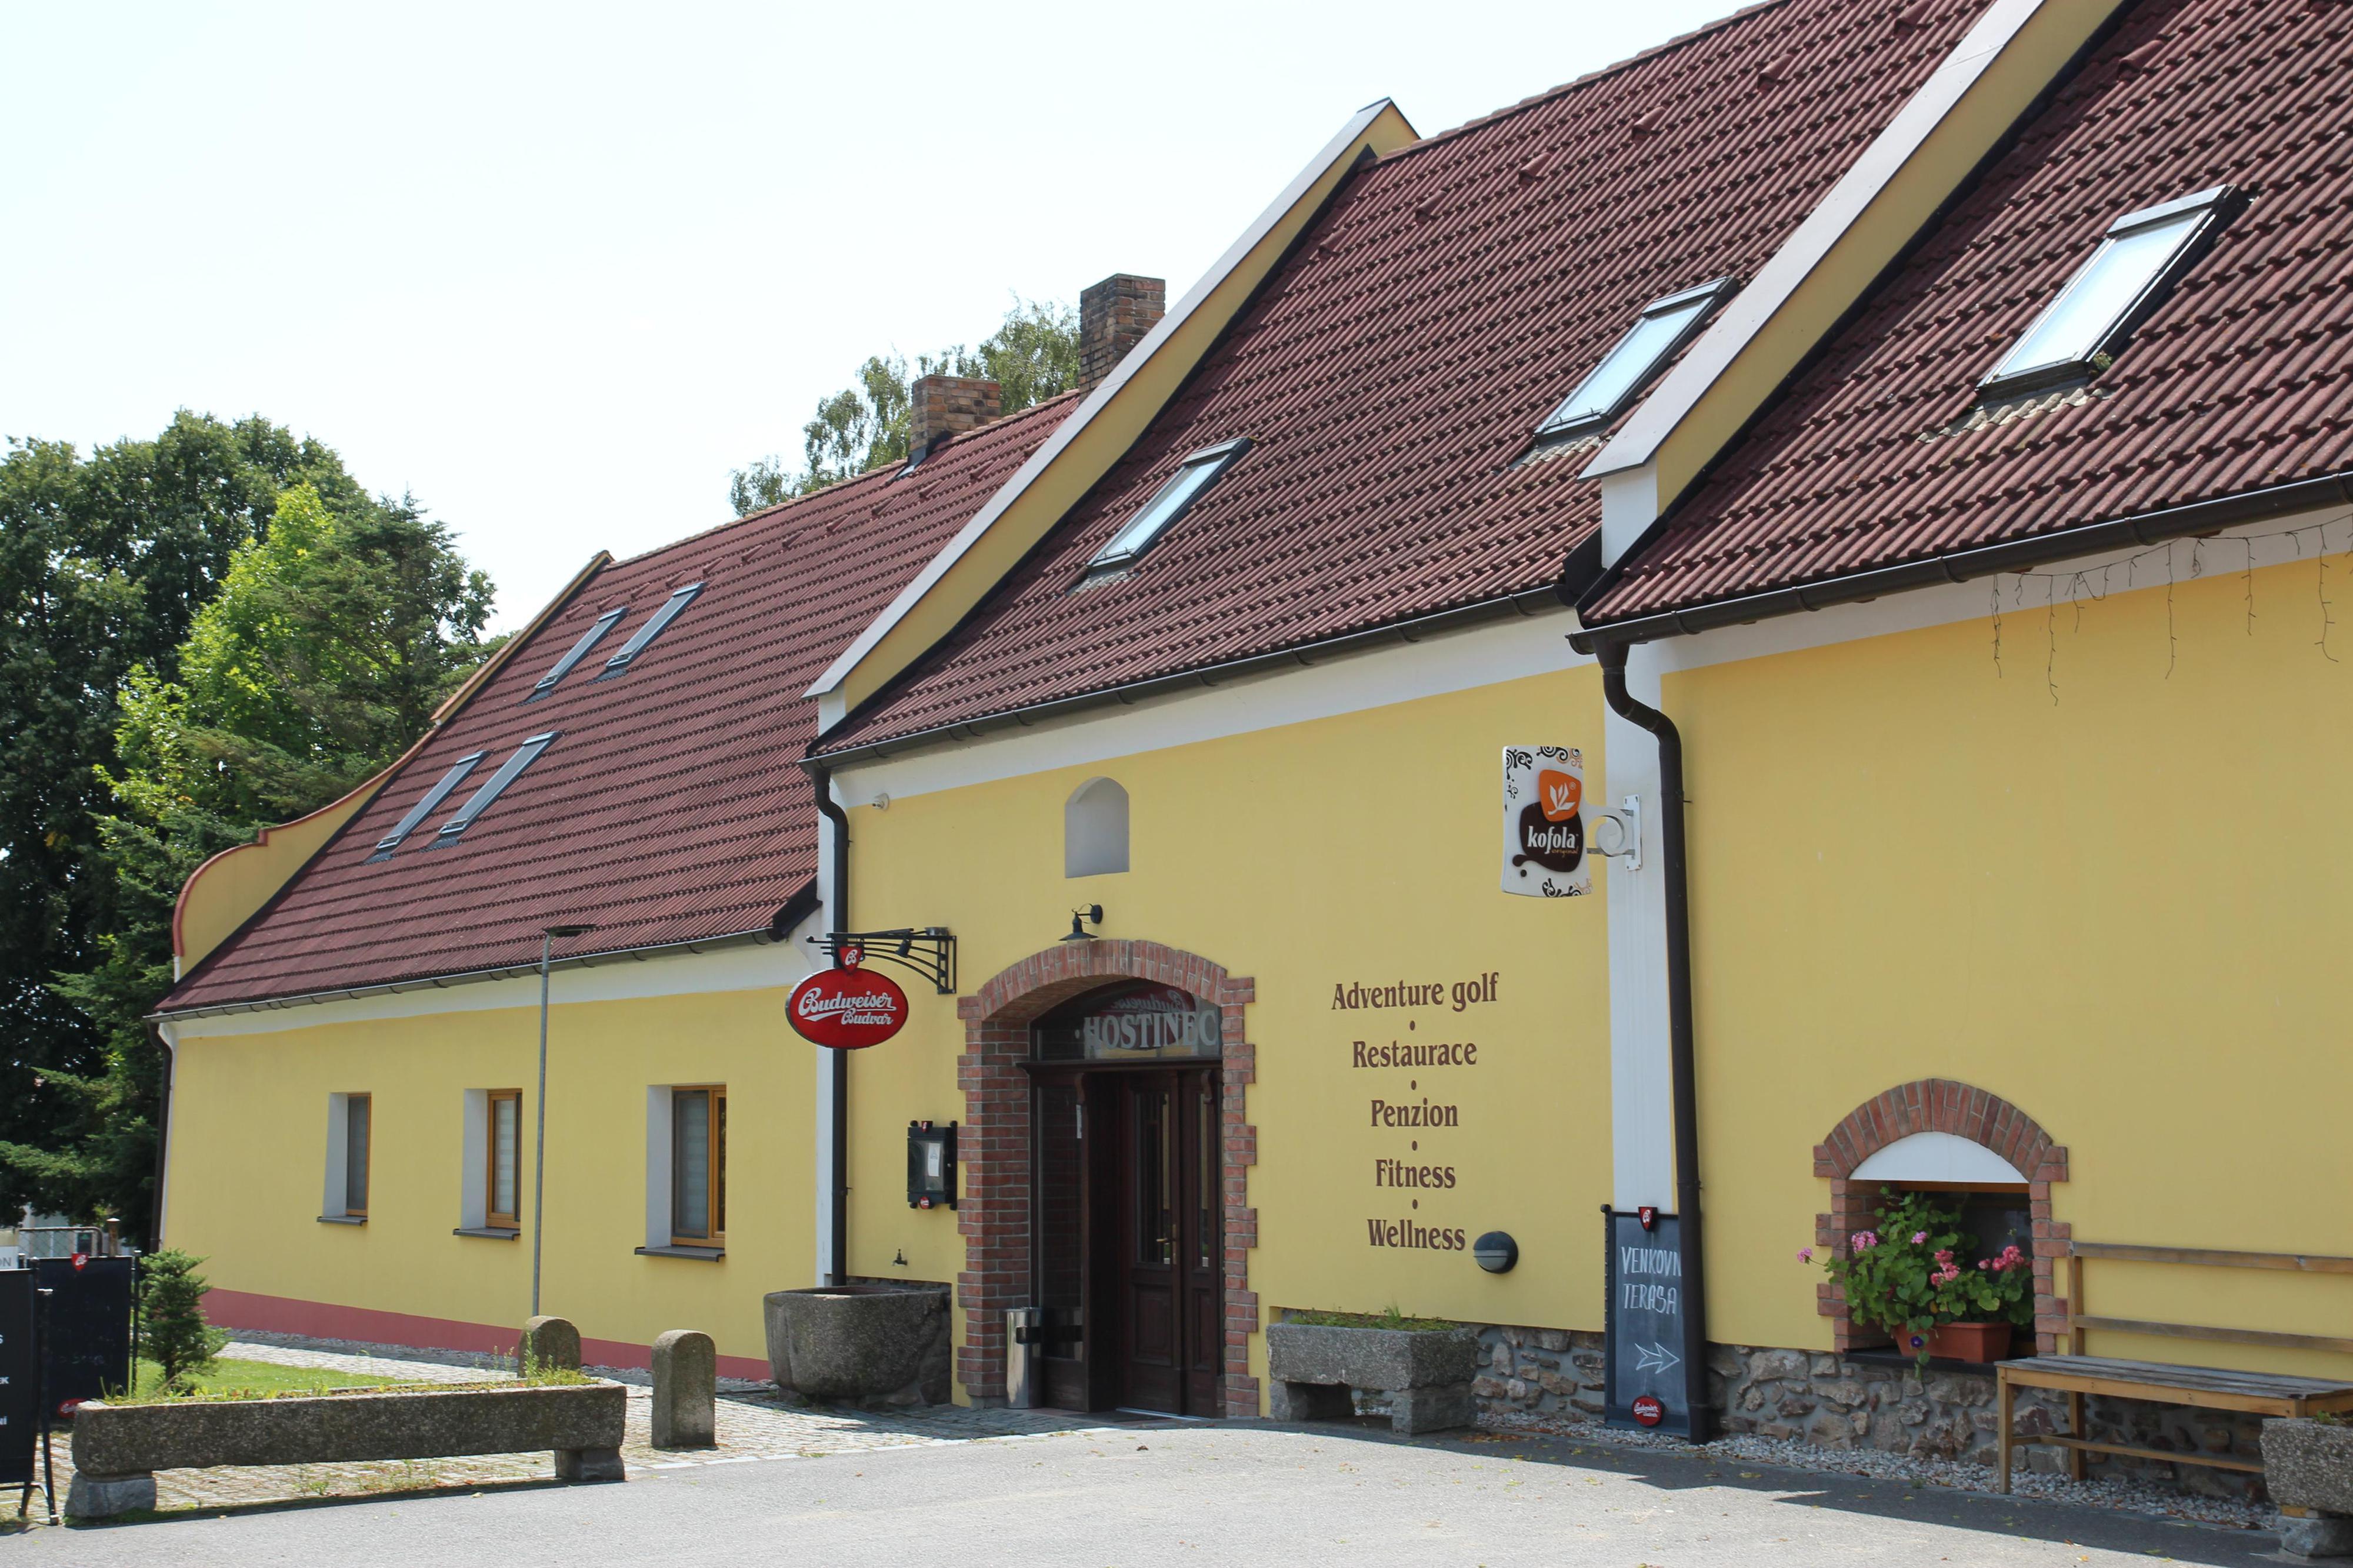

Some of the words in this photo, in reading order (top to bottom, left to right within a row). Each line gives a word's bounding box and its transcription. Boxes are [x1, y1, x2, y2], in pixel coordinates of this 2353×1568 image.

[1527, 825, 1575, 855] kofola
[798, 987, 896, 1016] Budweiser
[1331, 979, 1444, 1010] Adventure
[1452, 972, 1499, 1012] golf
[841, 1007, 894, 1025] Budvar
[1084, 1010, 1217, 1050] HOSTINEC
[1352, 1040, 1477, 1068] Restaurace
[1371, 1097, 1459, 1127] Penzion
[1375, 1158, 1456, 1189] Fitness
[1367, 1219, 1465, 1251] Wellness
[1621, 1246, 1682, 1277] VENKOVN
[1624, 1283, 1676, 1315] TERASA
